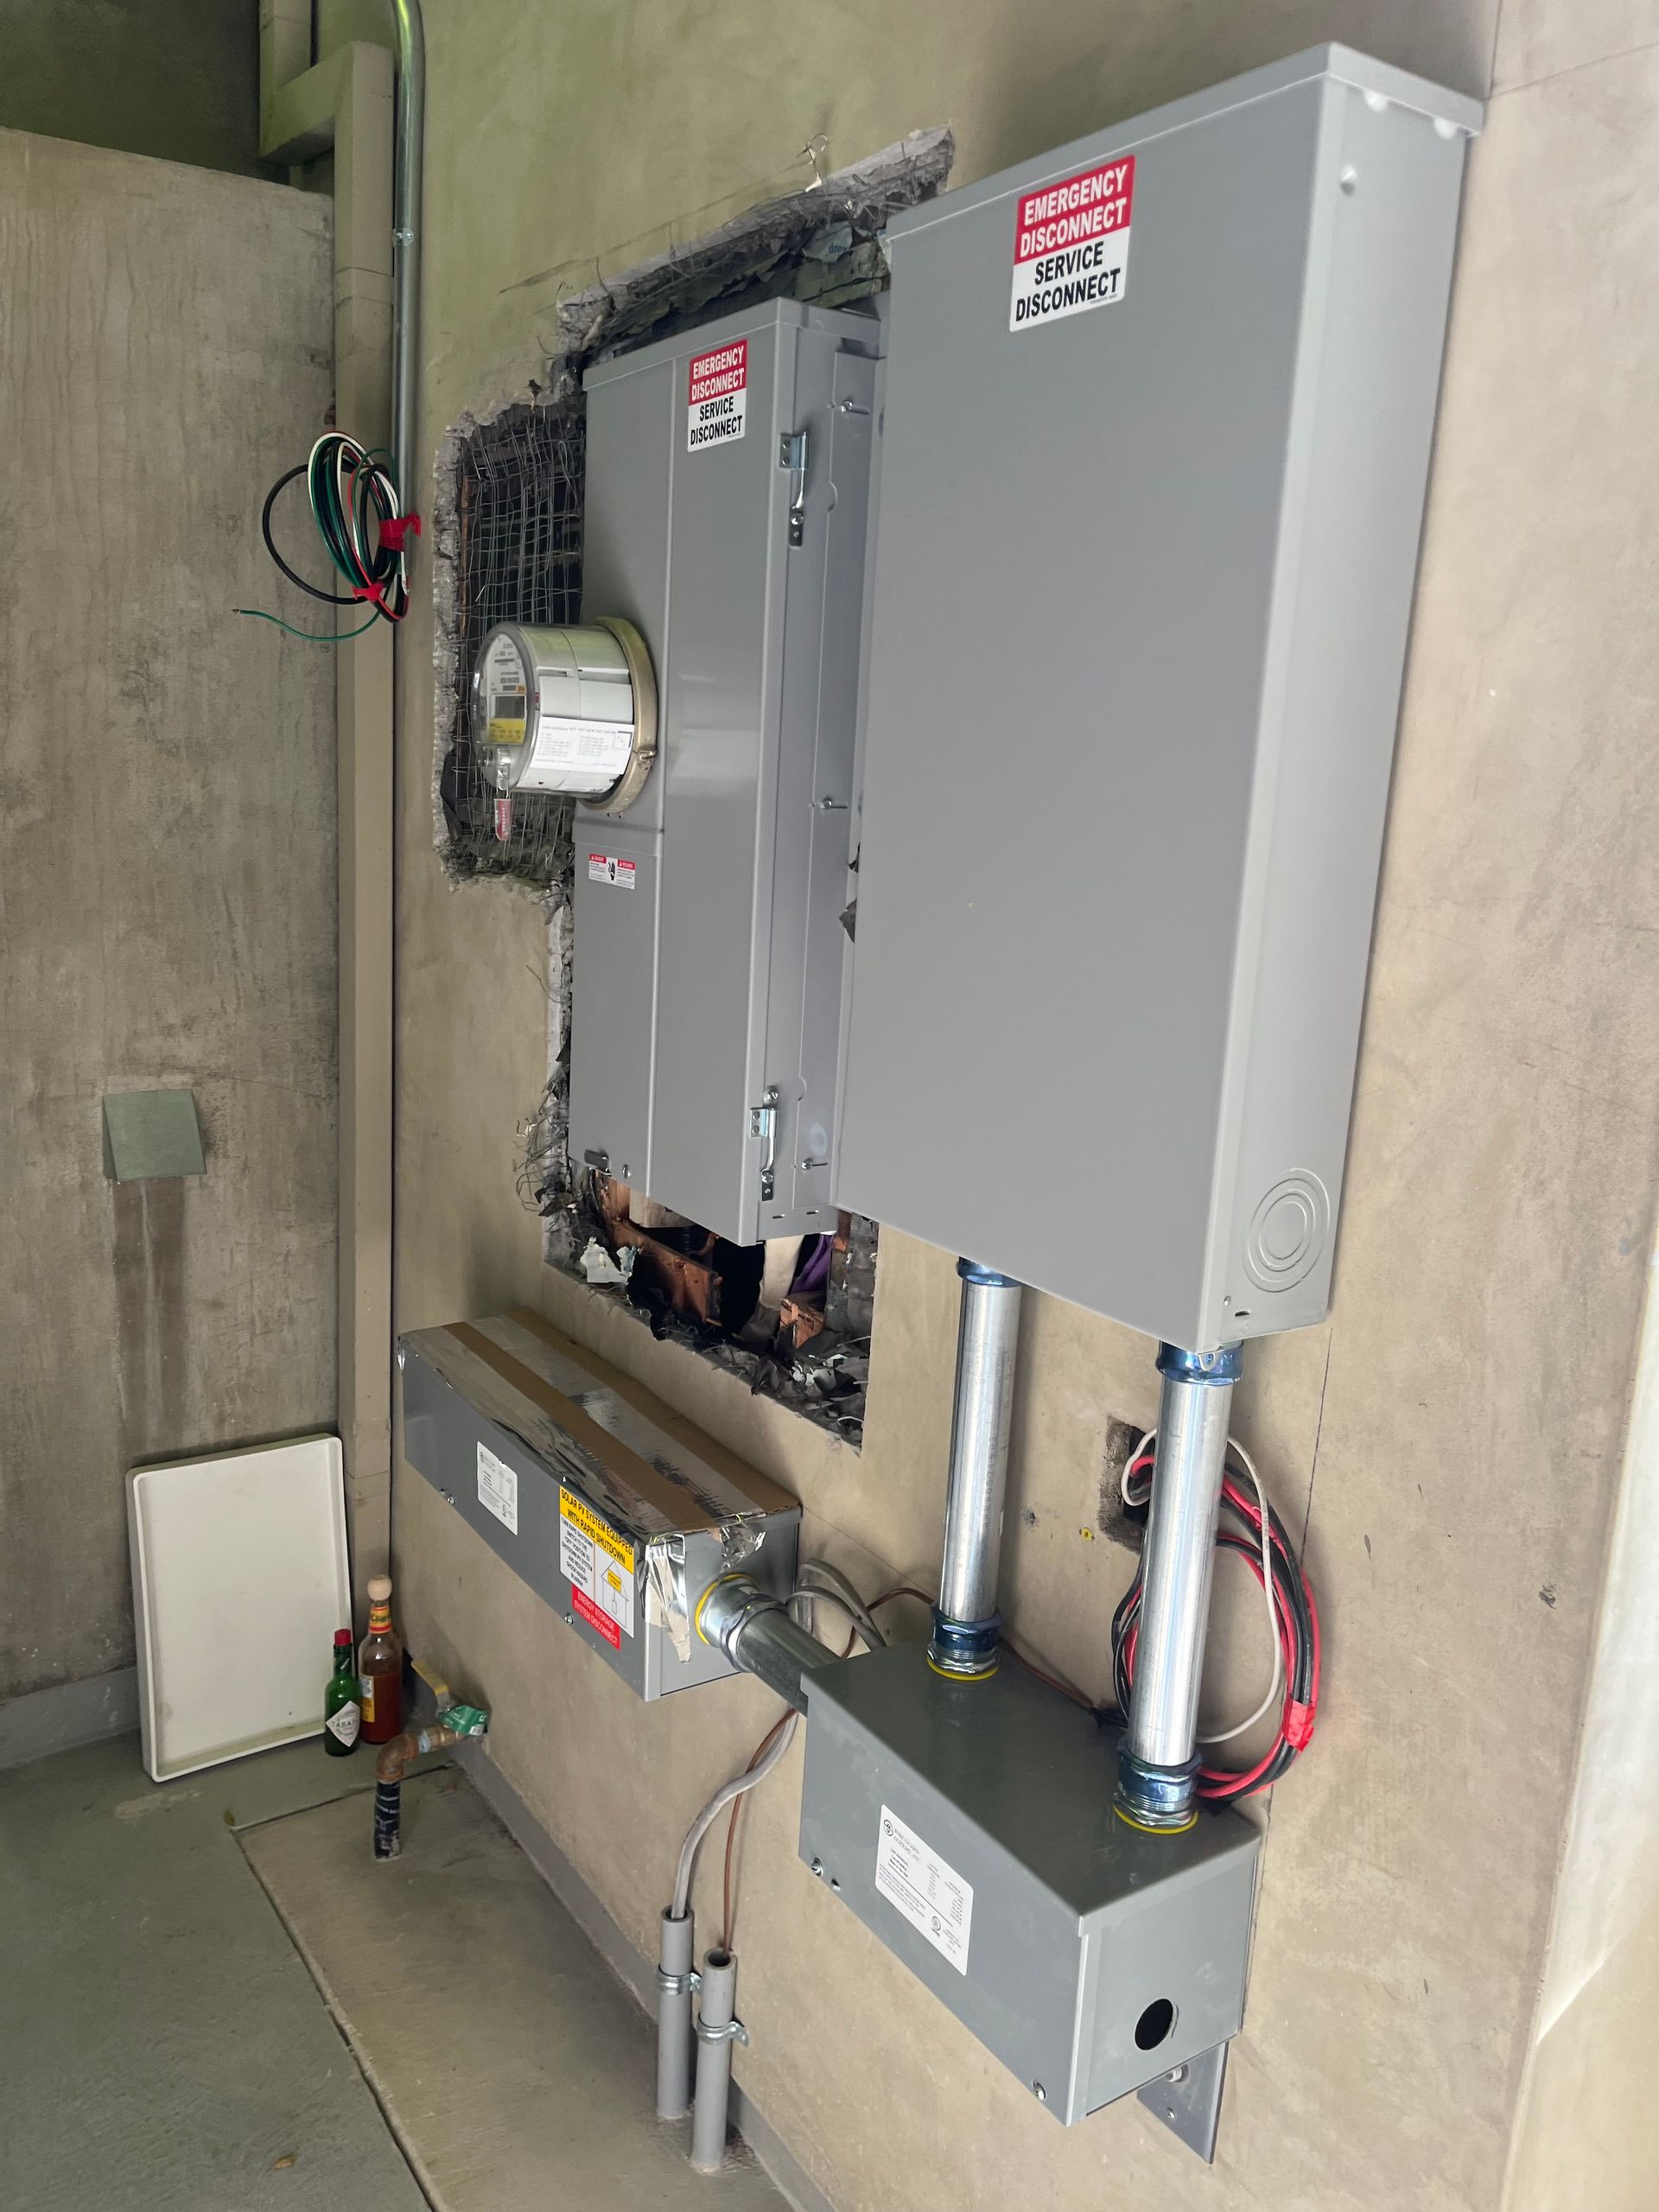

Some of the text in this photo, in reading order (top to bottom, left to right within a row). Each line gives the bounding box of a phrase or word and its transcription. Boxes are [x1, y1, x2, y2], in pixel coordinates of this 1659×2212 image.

[1024, 163, 1128, 226] EMERGENCY
[1020, 197, 1127, 258] DISCONNECT
[1034, 240, 1104, 286] SERVICE
[1015, 267, 1121, 322] DISCONNECT
[691, 367, 745, 402] DISCONNECT
[693, 346, 744, 380] EMERGENCY
[690, 415, 743, 446] DISCONNECT
[699, 396, 734, 422] SERVICE
[561, 1489, 633, 1555] SOLAR PV SYSTEM EQUIPPED
[568, 1508, 626, 1565] WITH RAPID SHUTDOWN
[574, 1599, 618, 1645] SYSTEM DISCONNECT
[577, 1591, 615, 1631] ENERGY STORAGE
